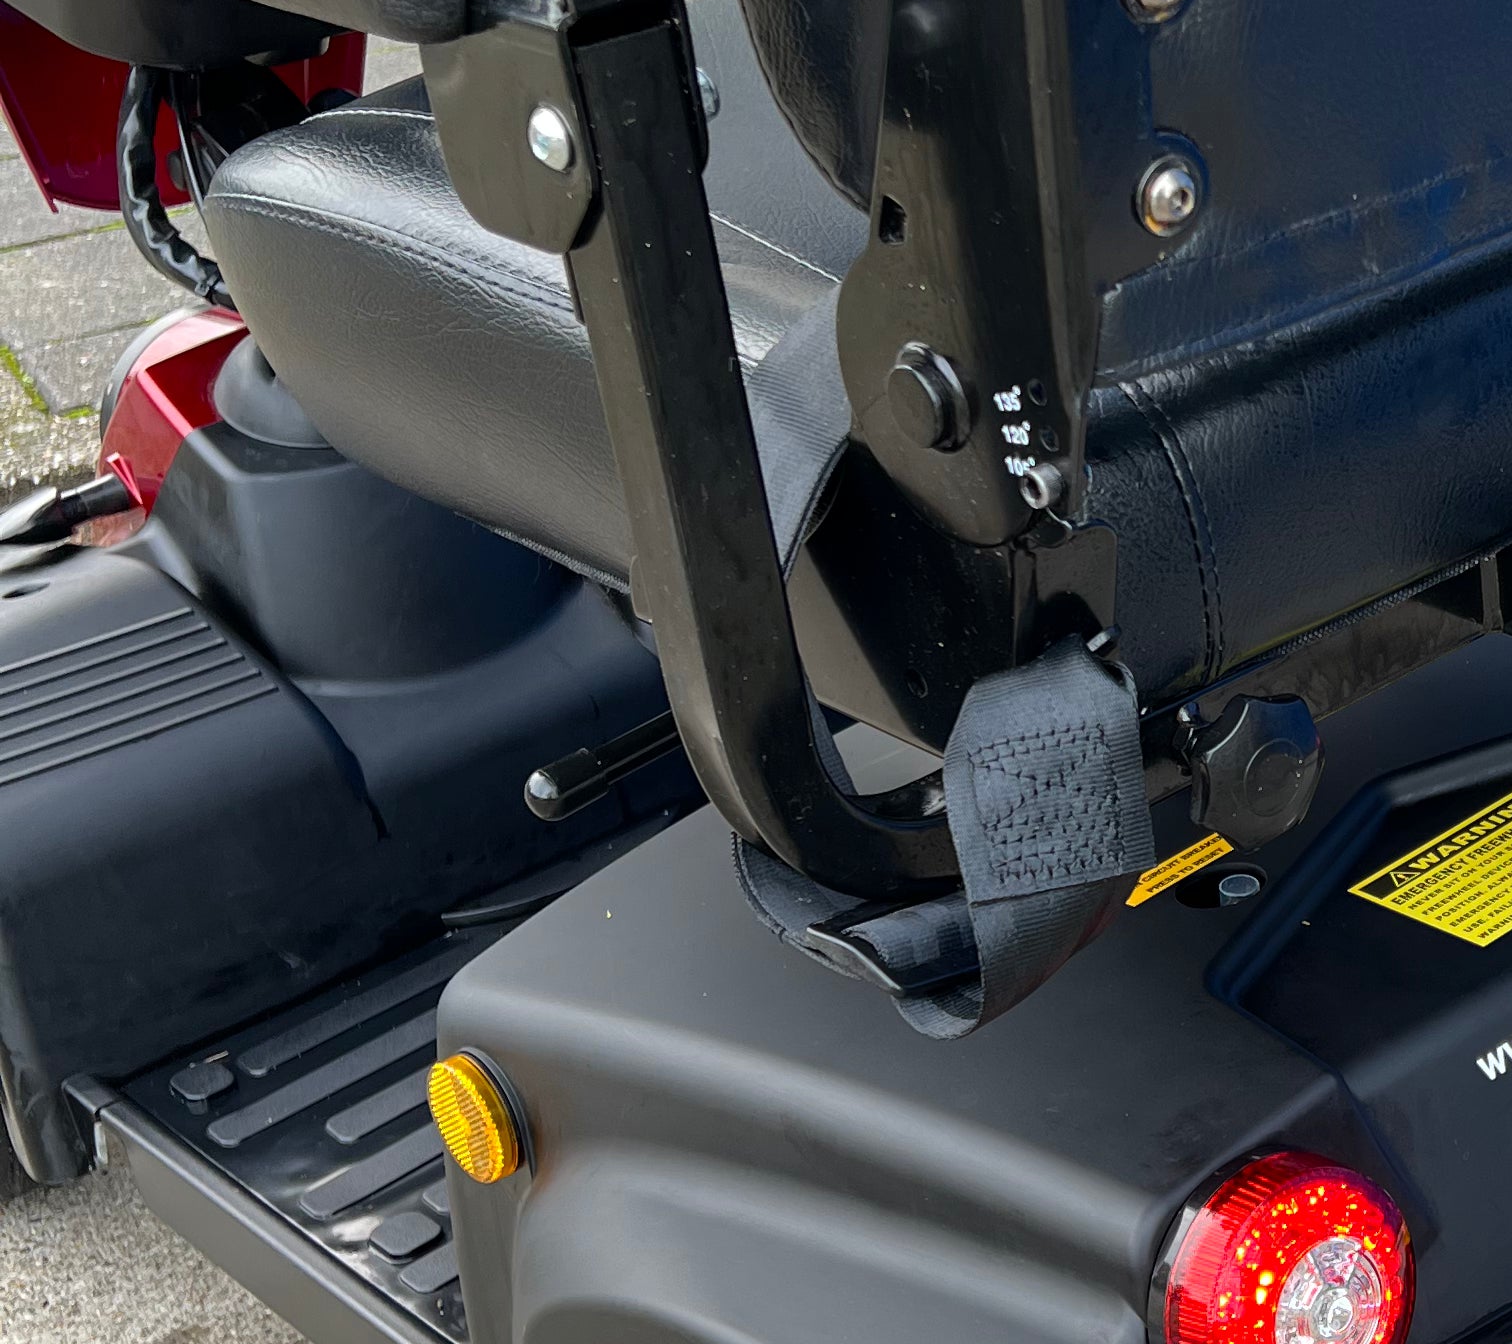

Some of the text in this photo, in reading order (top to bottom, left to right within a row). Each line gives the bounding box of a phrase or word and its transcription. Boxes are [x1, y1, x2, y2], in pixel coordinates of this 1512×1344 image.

[1389, 857, 1472, 905] EMERGENCY
[1406, 888, 1445, 910] NEVER
[1441, 877, 1463, 889] SIT
[1459, 867, 1479, 877] ON
[1475, 850, 1506, 868] YOUR
[1420, 879, 1481, 915] FREEWHEEL
[1434, 889, 1488, 921] POSITION.
[1448, 888, 1512, 927] EMERGENCY
[1462, 917, 1489, 932] USE.
